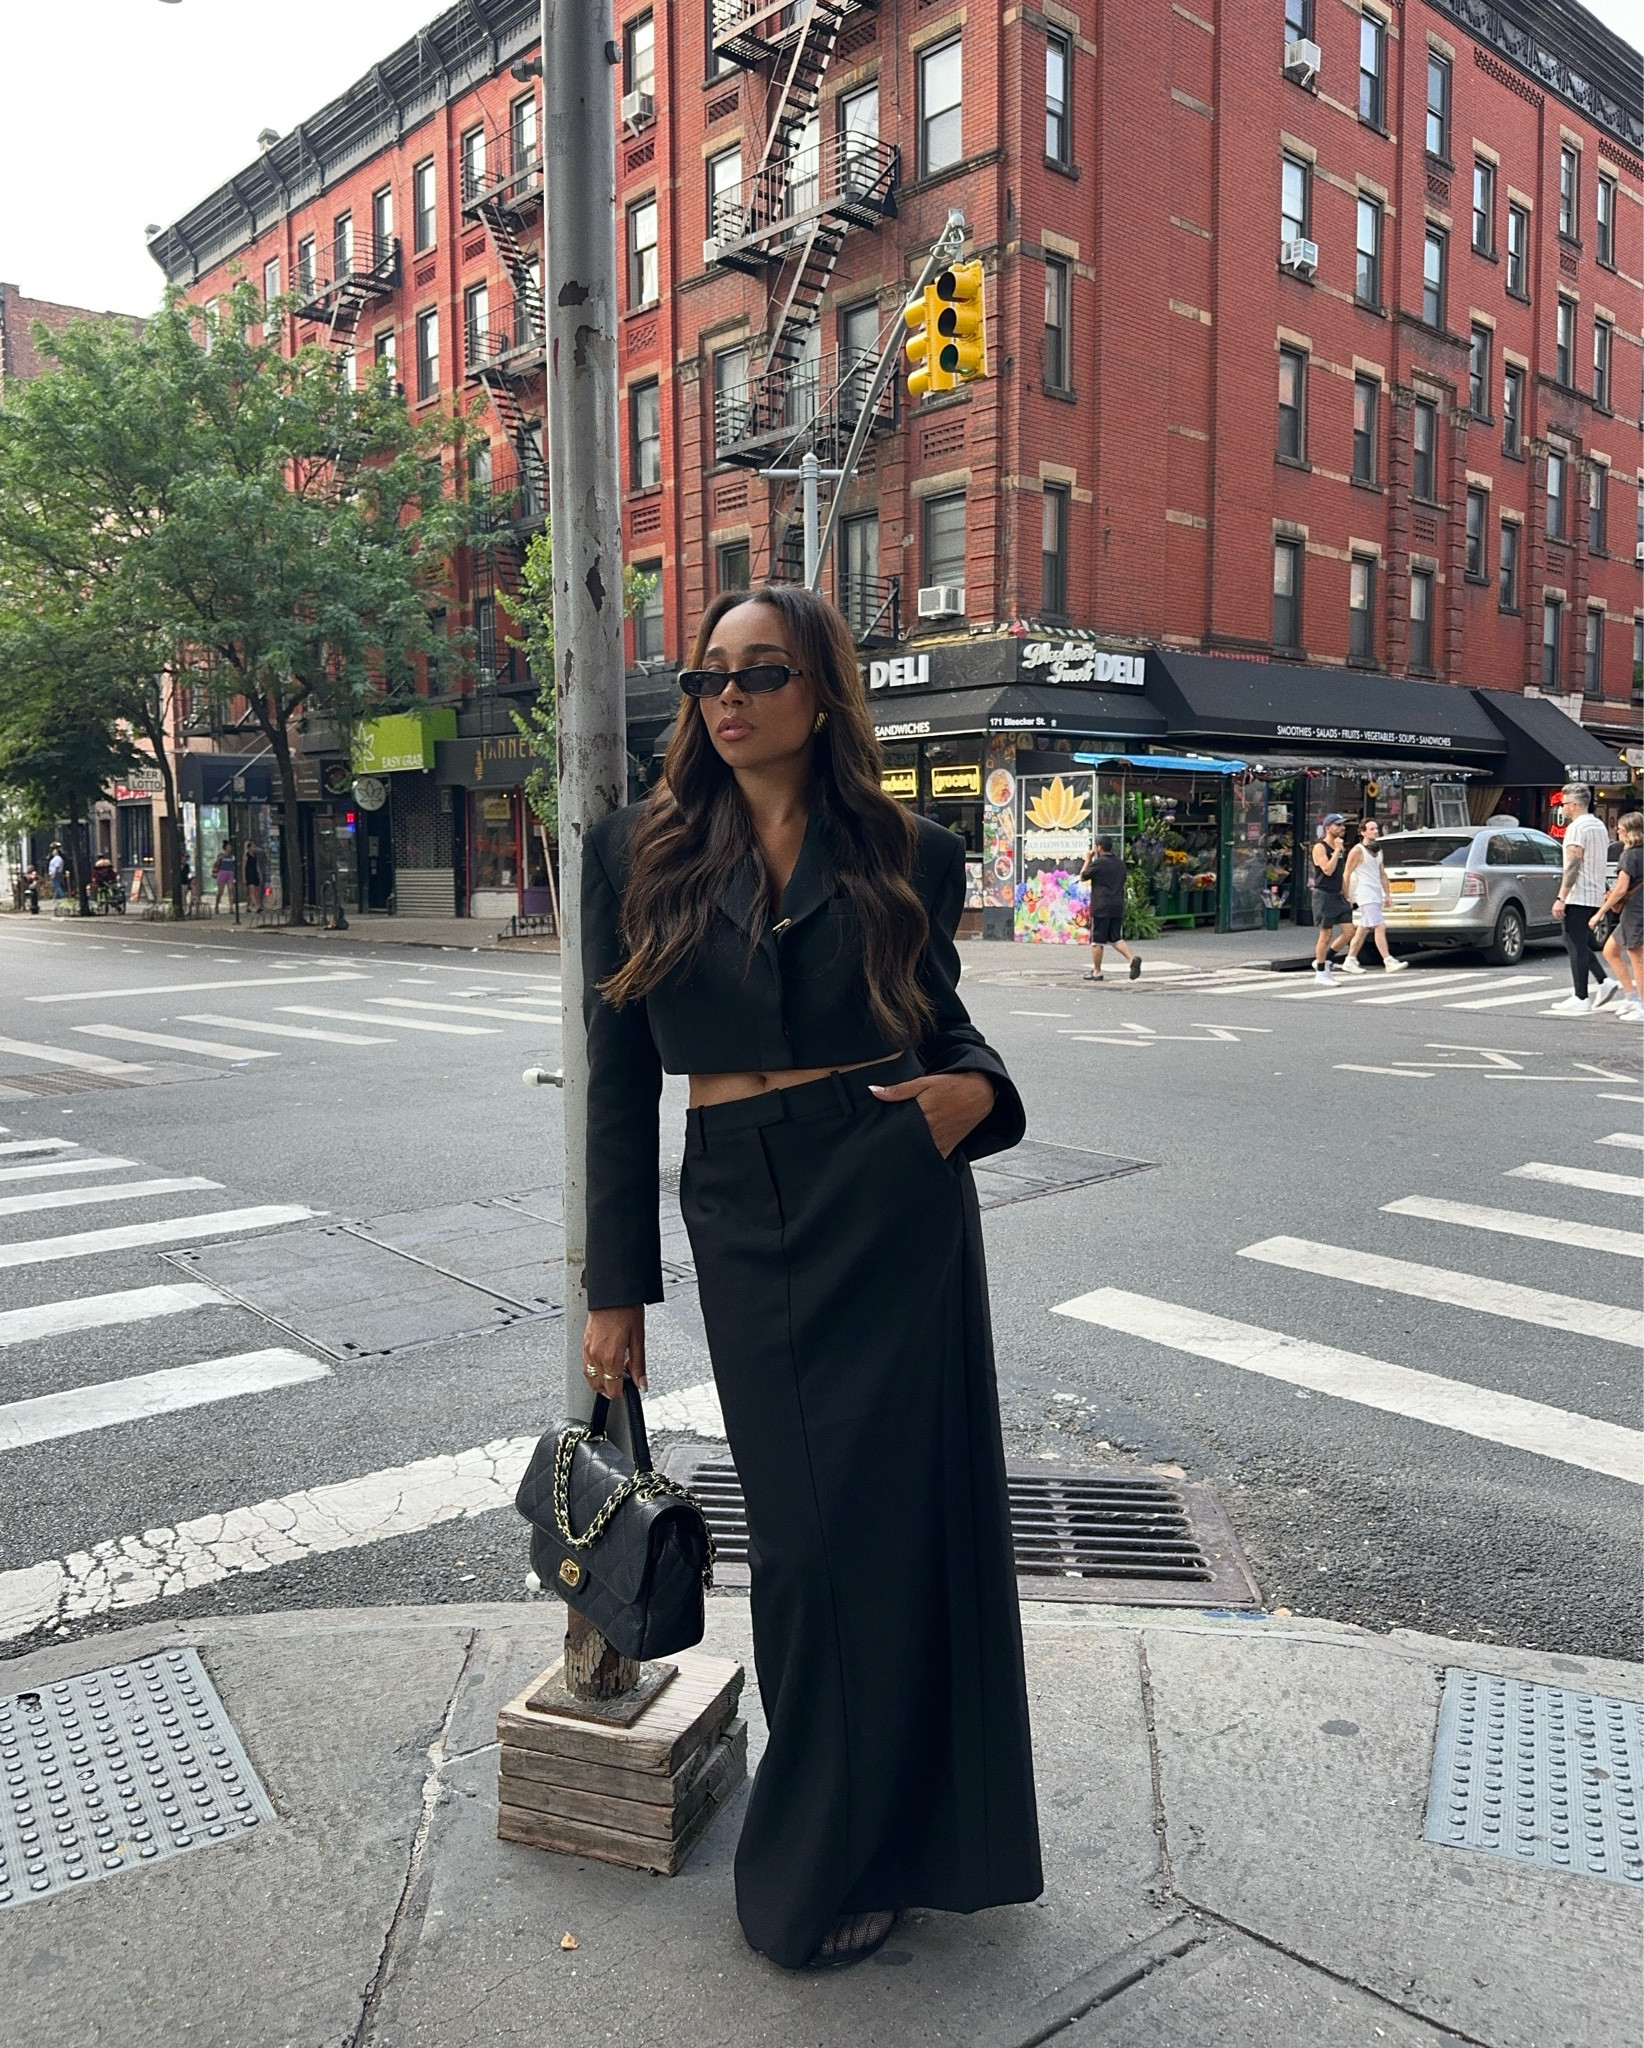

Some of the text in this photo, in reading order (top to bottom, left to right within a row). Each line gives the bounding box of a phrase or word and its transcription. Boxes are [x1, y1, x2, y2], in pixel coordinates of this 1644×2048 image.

[869, 654, 929, 689] DELI
[1093, 652, 1145, 686] DELI
[874, 721, 930, 737] SANDWICHES
[989, 716, 1046, 727] 171 Bleecker St.
[1276, 724, 1451, 747] SMOOTHIES SALADS FRUITS VEGETABLES SOUPS SANDWICHES
[482, 737, 538, 760] TANNER
[381, 754, 424, 768] EASY GRAB
[136, 771, 158, 780] EER
[935, 774, 977, 792] grocery
[132, 780, 162, 790] LOTTO
